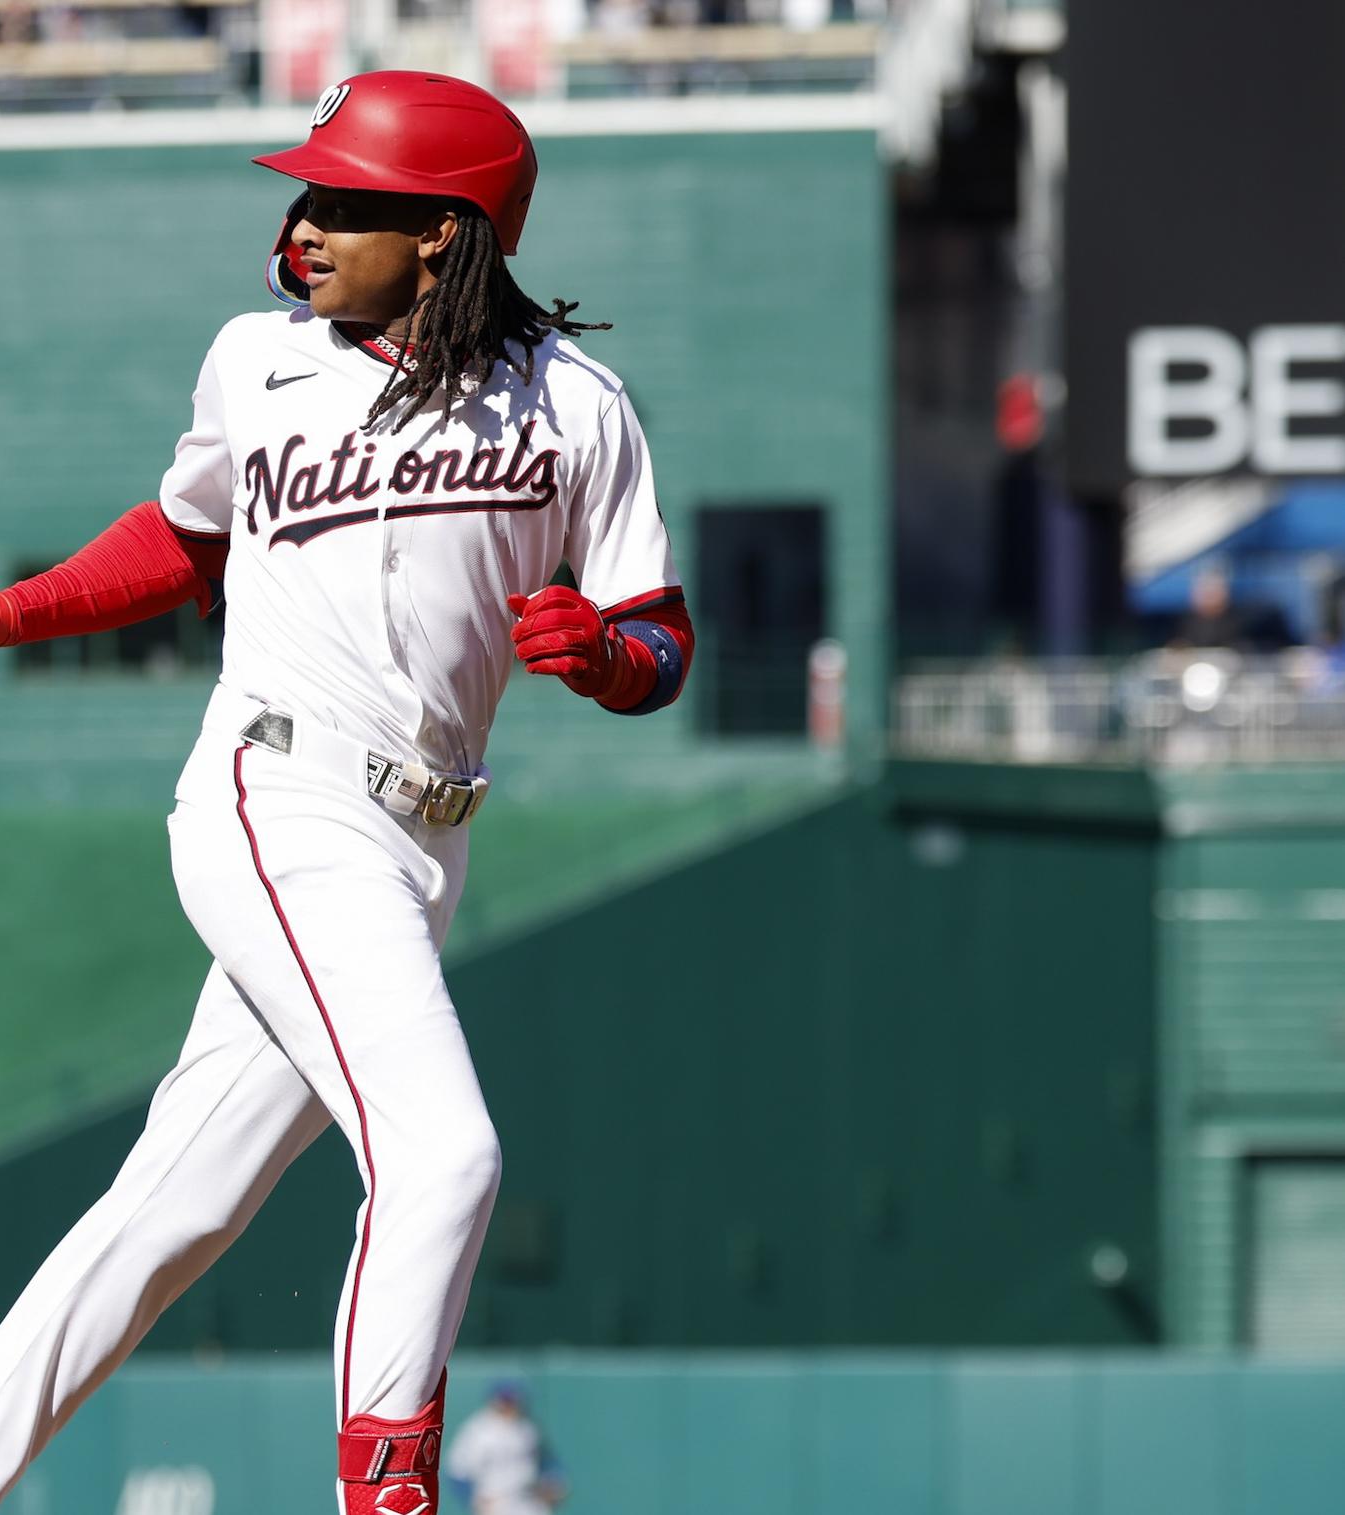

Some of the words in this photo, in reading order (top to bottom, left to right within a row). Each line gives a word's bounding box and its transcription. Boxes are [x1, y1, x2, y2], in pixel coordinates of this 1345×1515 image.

[310, 84, 351, 130] W
[1127, 324, 1345, 474] BE
[246, 420, 559, 535] Nationals
